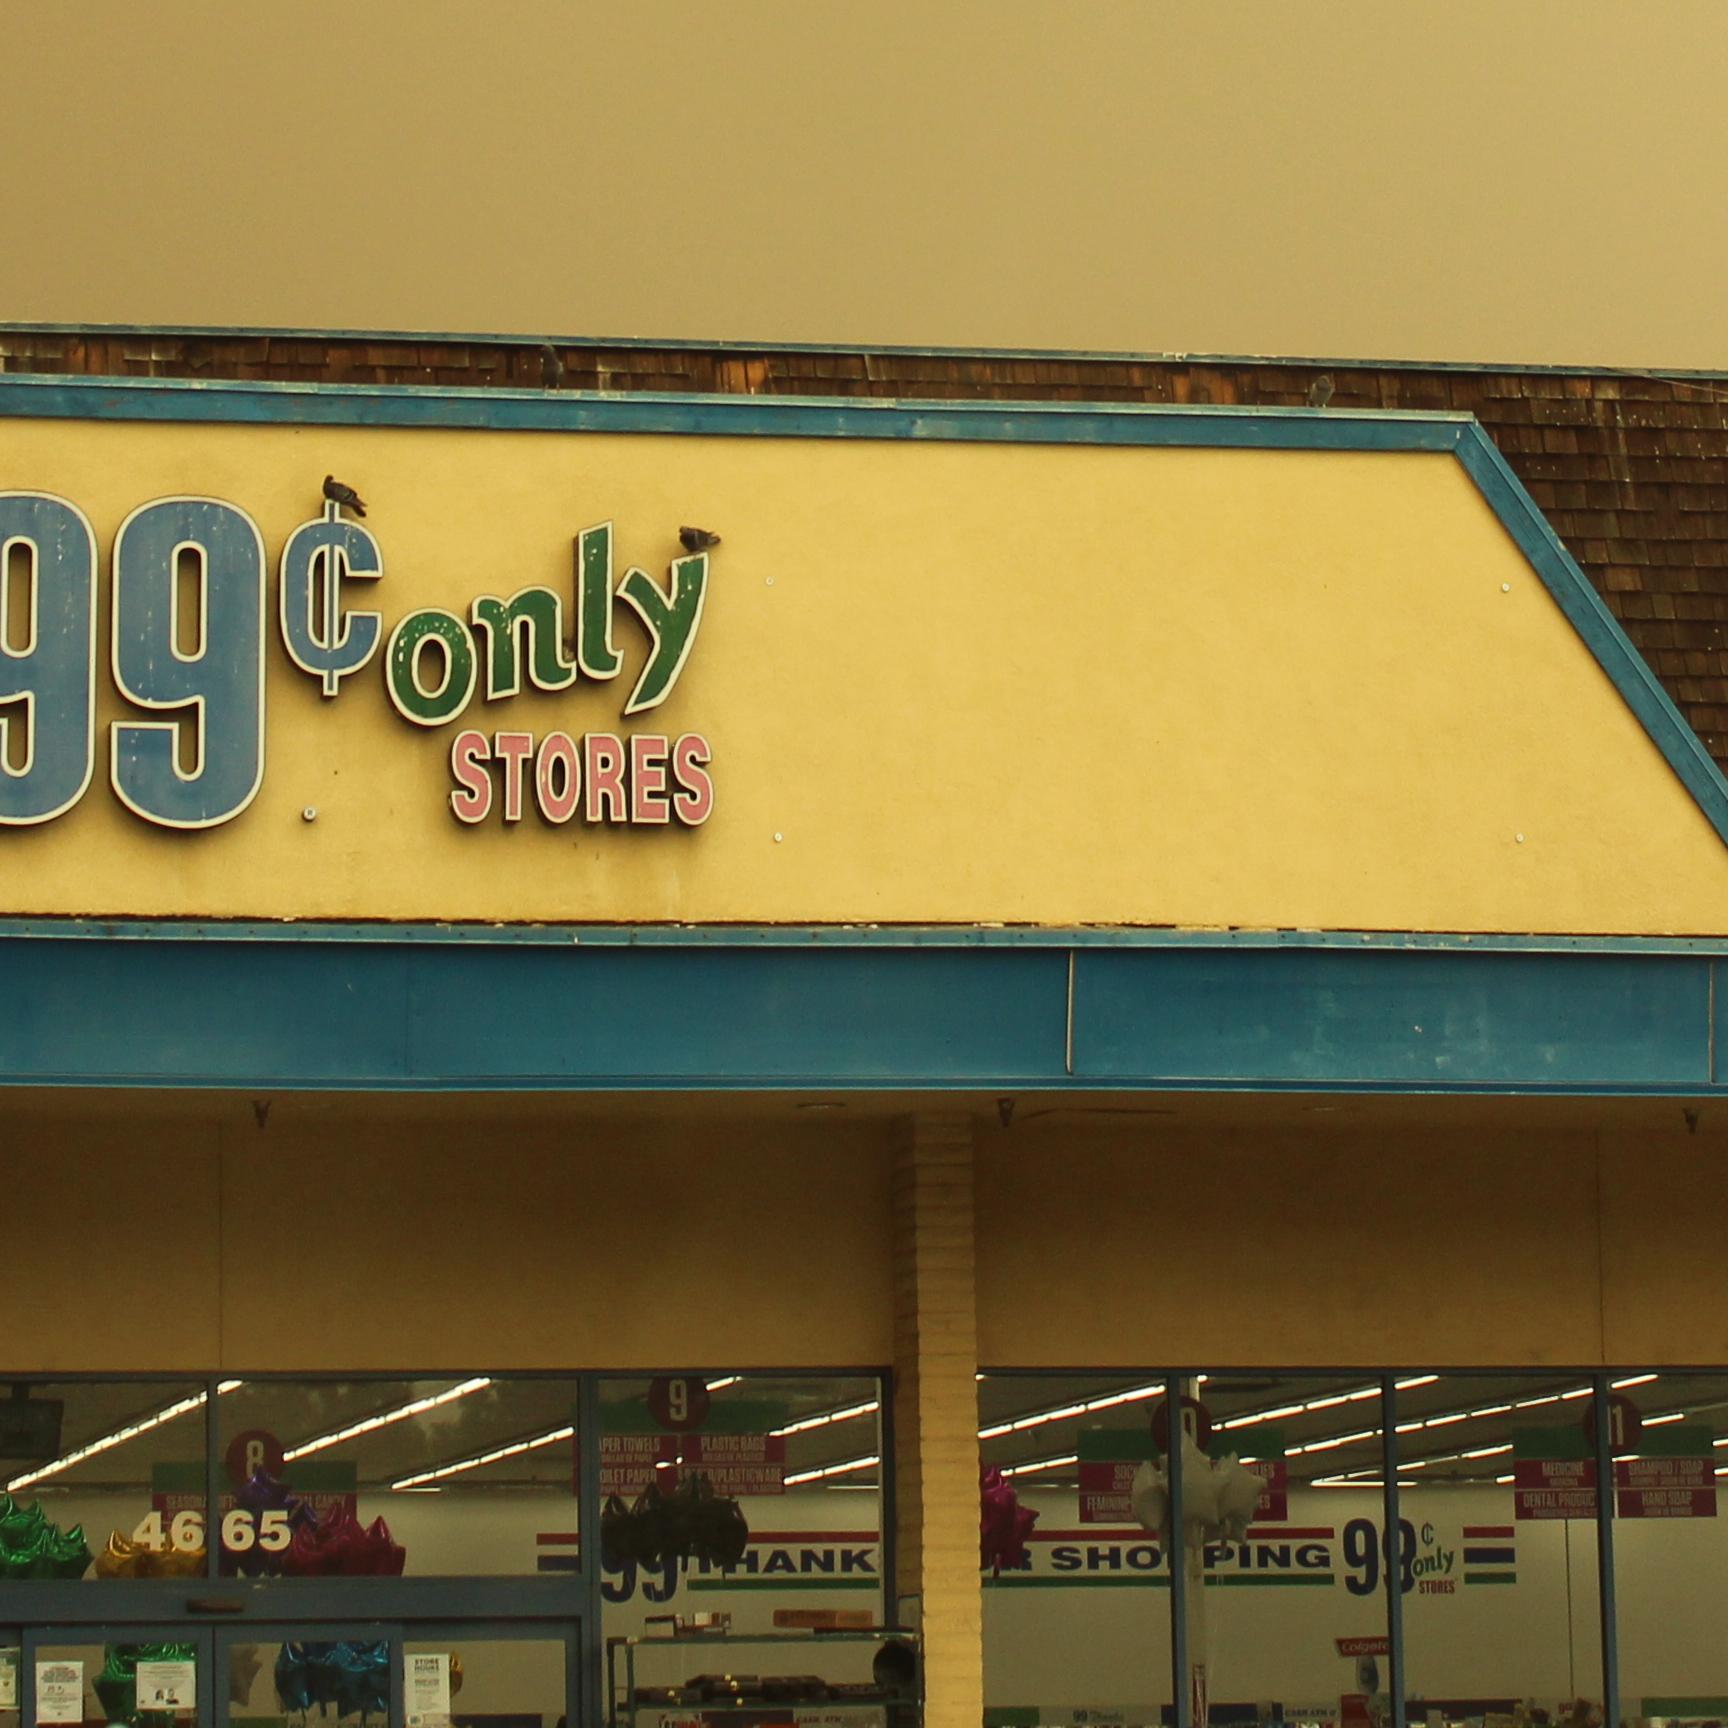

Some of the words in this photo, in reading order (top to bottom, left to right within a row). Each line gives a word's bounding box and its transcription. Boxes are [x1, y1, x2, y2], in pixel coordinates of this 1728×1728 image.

[386, 520, 710, 726] only
[451, 729, 713, 826] STORES
[668, 1378, 687, 1421] 9
[623, 1436, 660, 1452] TOWELS
[701, 1436, 739, 1452] PLASTIC
[741, 1436, 765, 1452] BAGS
[599, 1468, 625, 1483] OILET
[627, 1468, 657, 1483] PAPER
[1542, 1461, 1585, 1476] MEDICINE
[1524, 1493, 1556, 1508] DENTAL
[1559, 1492, 1596, 1507] PRODUC
[1642, 1491, 1666, 1505] HAND
[1668, 1491, 1692, 1505] SOAP
[1051, 1543, 1330, 1570] SHOPING
[1413, 1546, 1454, 1577] only
[1419, 1580, 1455, 1595] STORES
